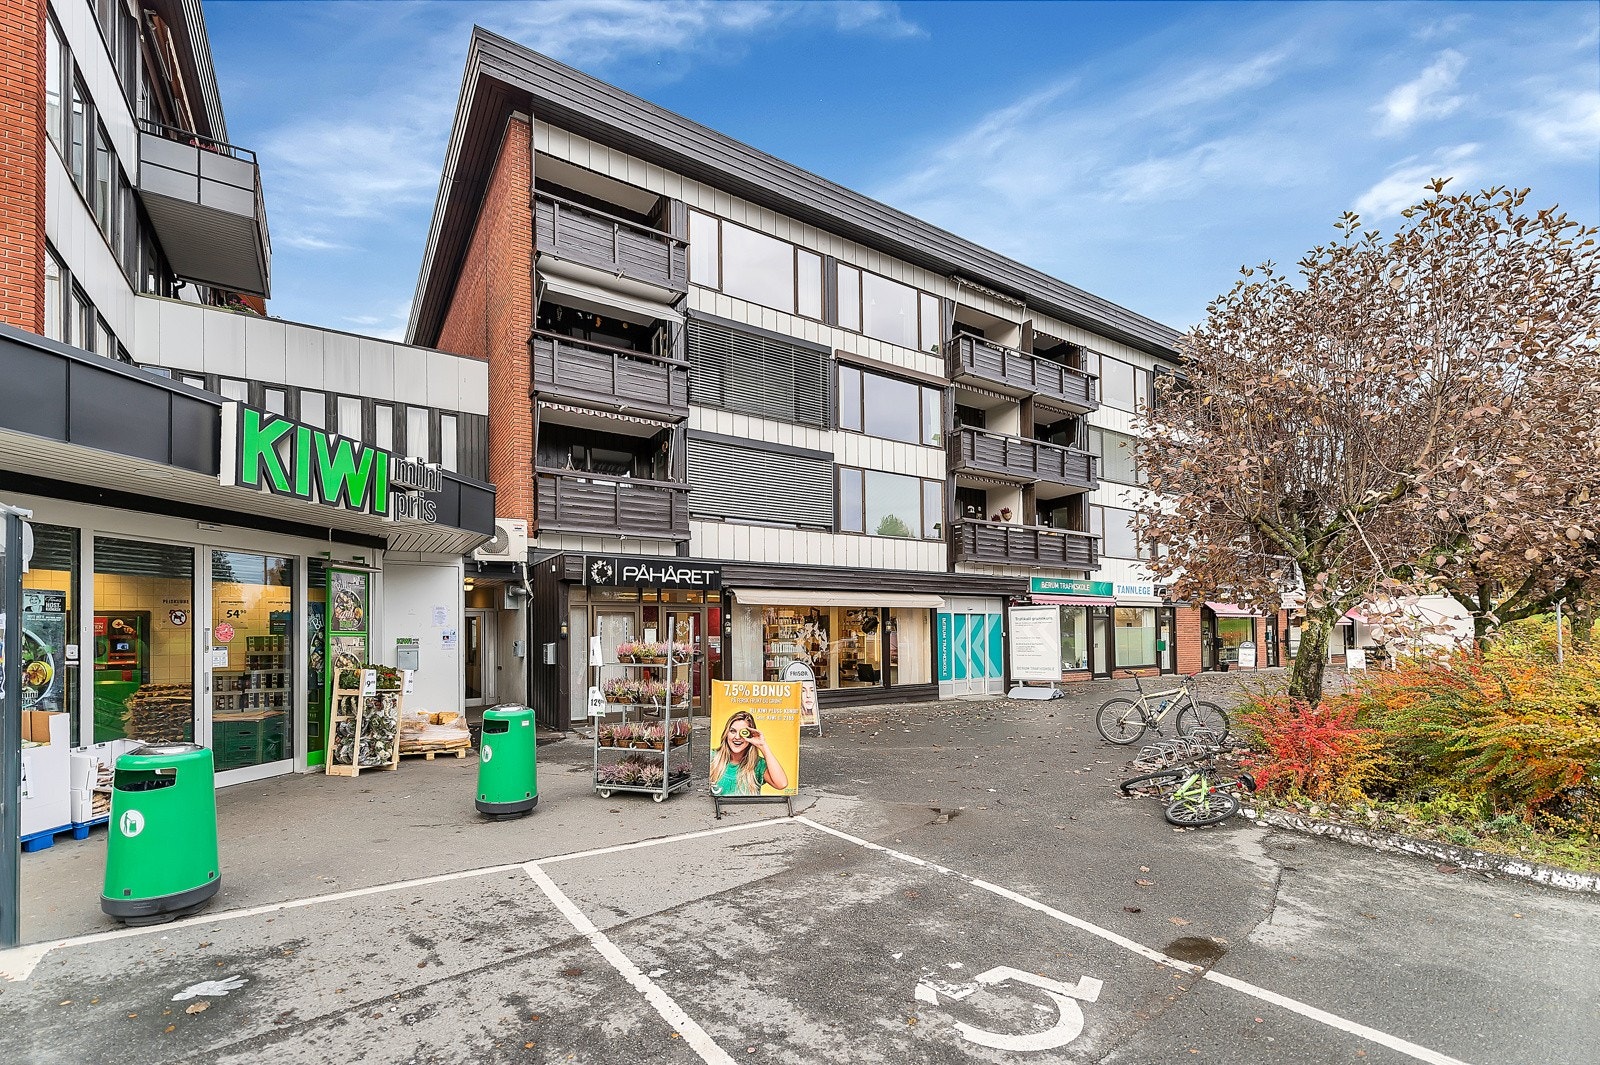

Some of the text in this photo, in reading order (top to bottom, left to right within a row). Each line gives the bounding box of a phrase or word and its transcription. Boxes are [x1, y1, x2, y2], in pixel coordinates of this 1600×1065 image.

[241, 406, 388, 514] KIWI
[396, 457, 443, 493] mini
[395, 489, 437, 523] pris
[622, 563, 715, 585] PÅHÅRET
[1116, 585, 1151, 595] TANNLEGE
[752, 684, 791, 697] BONUS
